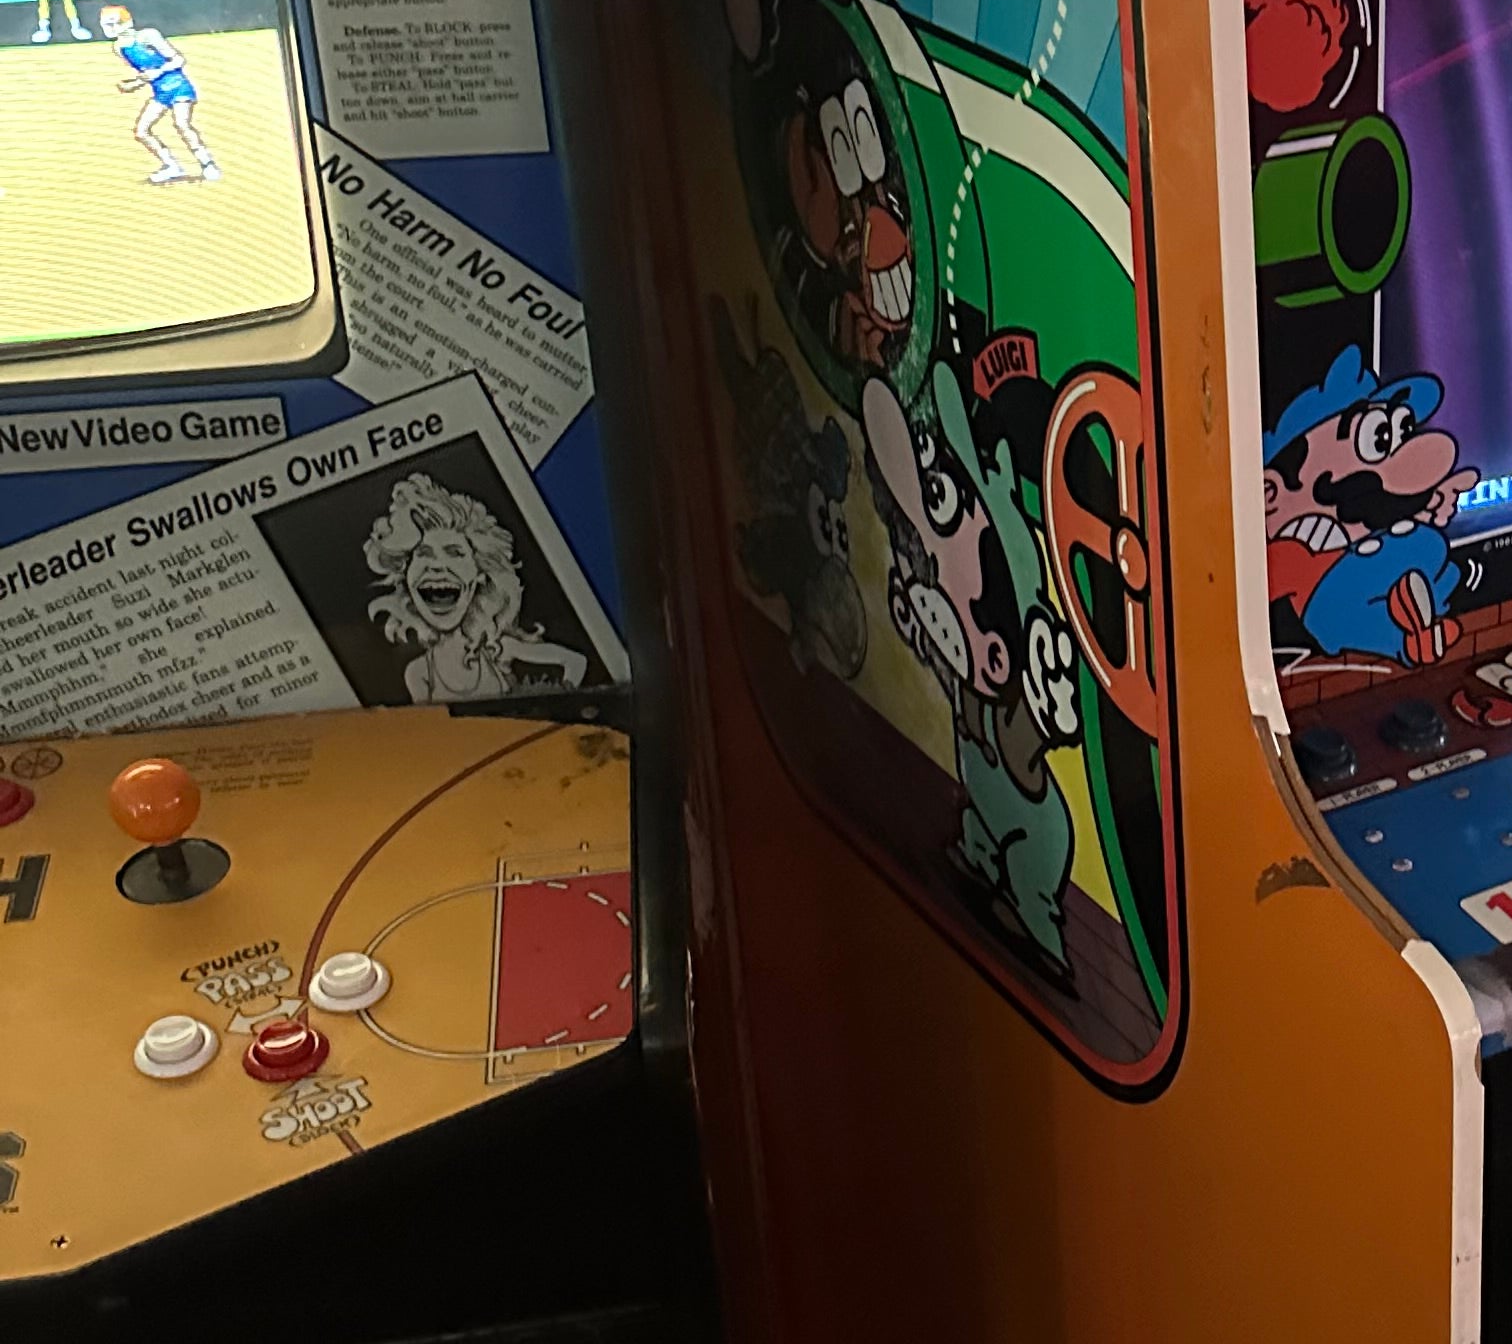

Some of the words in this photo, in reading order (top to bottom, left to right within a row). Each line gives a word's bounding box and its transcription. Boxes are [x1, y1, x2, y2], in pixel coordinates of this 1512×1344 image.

[320, 154, 365, 196] No
[368, 189, 455, 257] Harm
[457, 249, 506, 290] No
[508, 283, 585, 341] Foul
[359, 262, 383, 283] the
[359, 219, 387, 244] One
[392, 243, 442, 279] official
[445, 276, 472, 299] was
[476, 295, 519, 329] heard
[521, 326, 535, 340] to
[370, 289, 385, 304] is
[389, 304, 408, 320] an
[350, 299, 417, 345] shrugged
[371, 333, 436, 378] naturally
[465, 312, 482, 327] as
[484, 320, 502, 340] he
[505, 336, 531, 357] was
[532, 355, 583, 390] carried
[980, 340, 1029, 389] LUIGI
[0, 423, 68, 455] New
[71, 417, 172, 447] Video
[180, 410, 281, 440] Game
[127, 474, 277, 547] Swallows
[286, 446, 360, 487] Own
[367, 409, 444, 456] Face
[44, 578, 115, 613] accident
[158, 544, 204, 570] night
[210, 530, 238, 549] col-
[111, 585, 151, 608] Suzi
[167, 550, 250, 587] Markglen
[16, 648, 46, 667] her
[53, 623, 109, 653] mouth
[114, 616, 133, 631] so
[137, 598, 178, 619] wide
[183, 586, 211, 604] she
[218, 569, 257, 590] actu-
[2, 651, 88, 695] swallowed
[90, 641, 120, 660] her
[127, 627, 162, 646] own
[137, 646, 167, 664] she
[191, 683, 235, 706] cheer
[241, 665, 273, 688] and
[276, 659, 296, 675] as
[299, 655, 310, 666] a
[84, 681, 186, 726] enthusiastic
[191, 665, 229, 685] fans
[236, 693, 259, 710] for
[270, 671, 318, 697] minor
[181, 939, 280, 983] (PUNCH)
[193, 957, 294, 1005] PASS
[259, 1076, 372, 1141] SHOOT
